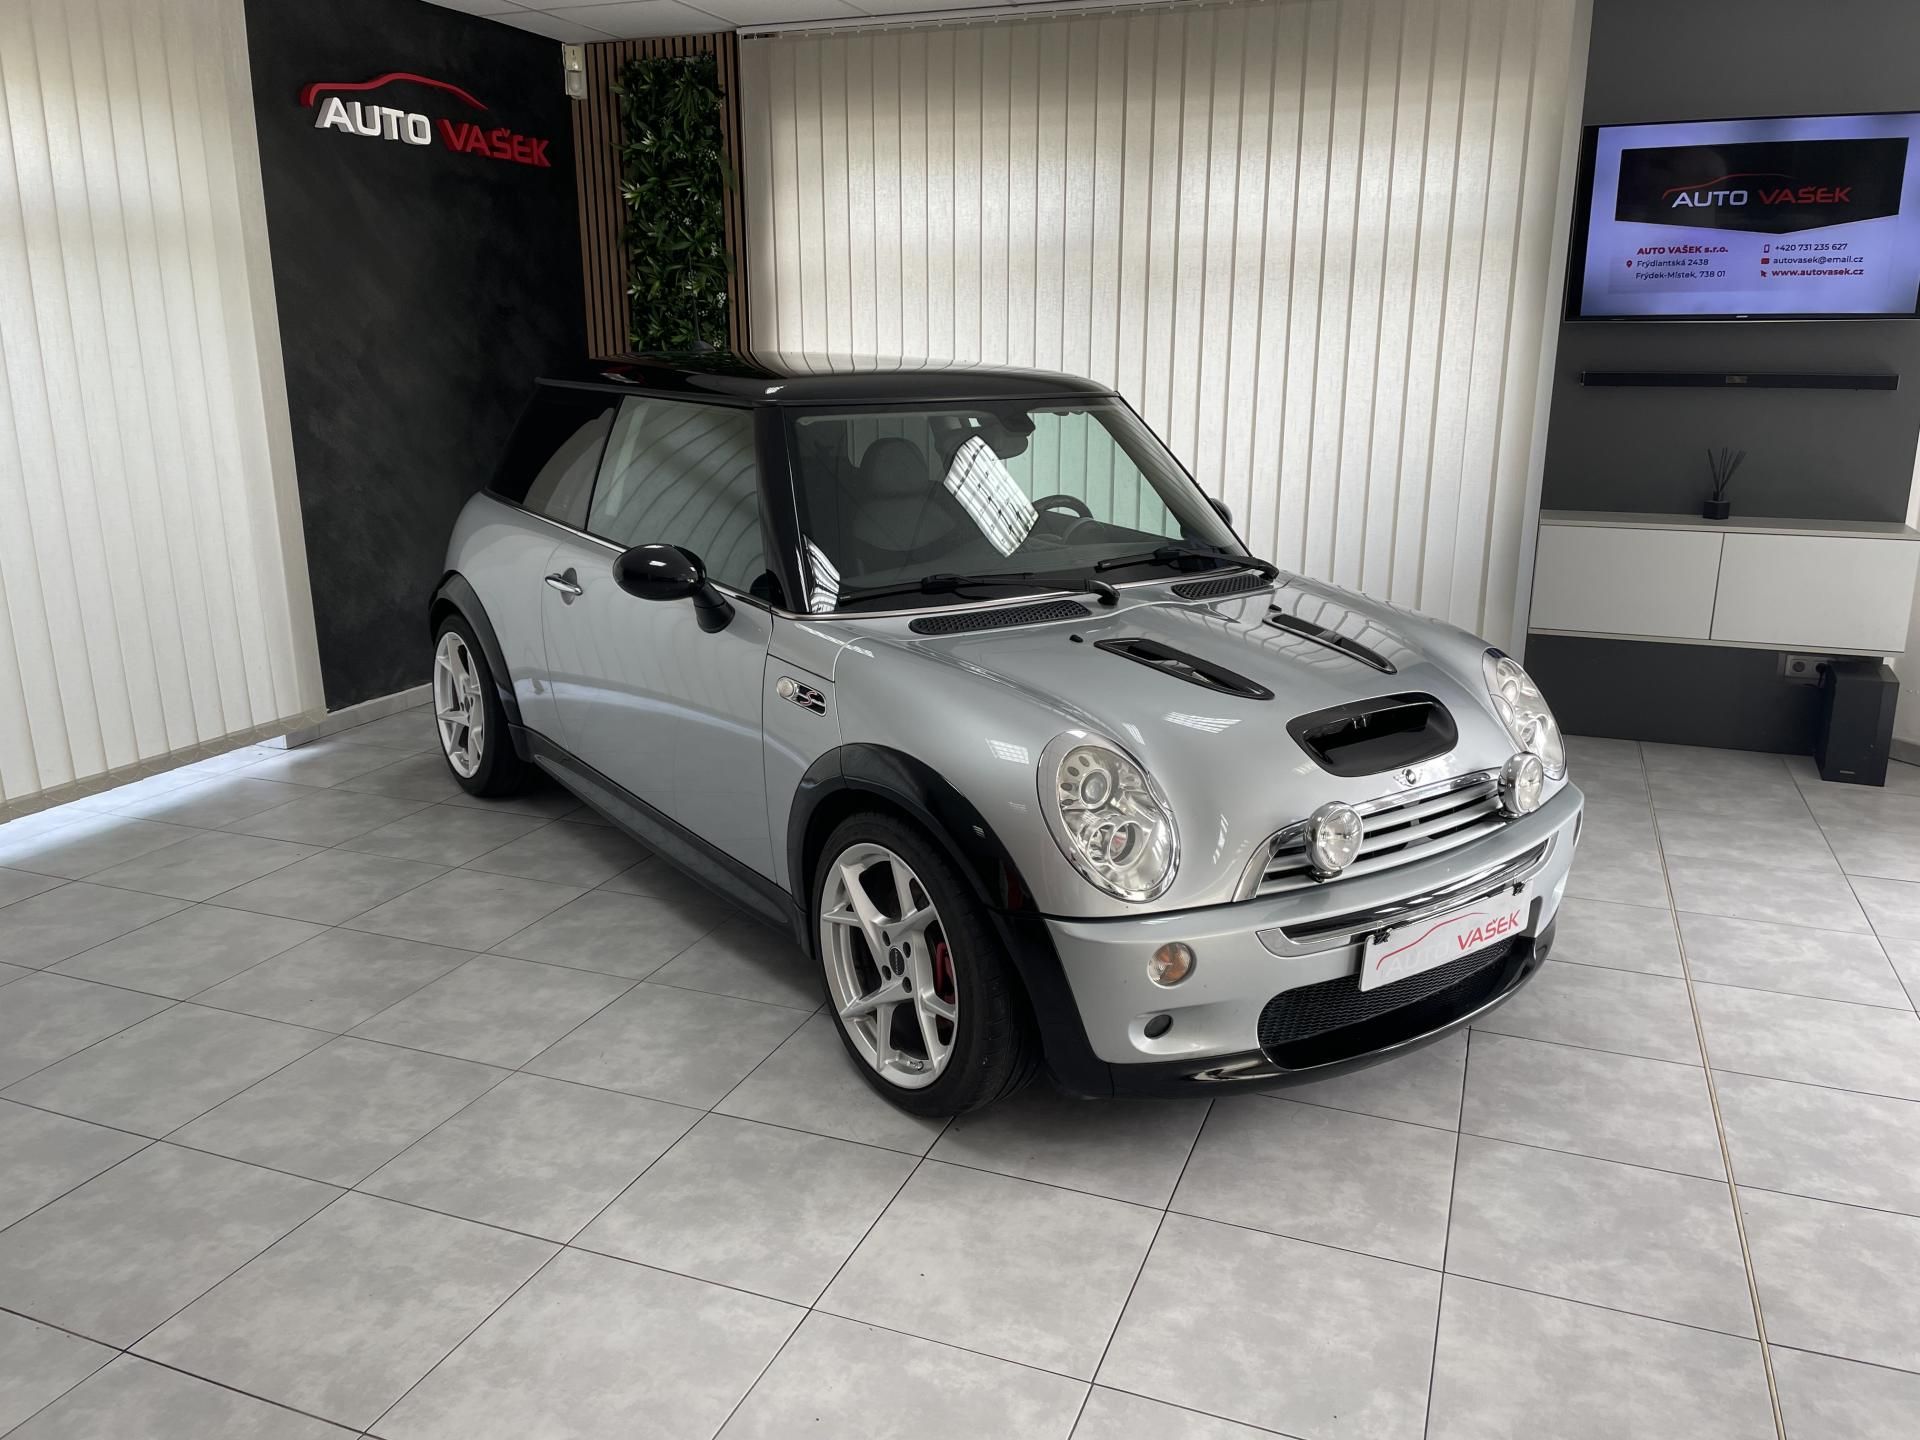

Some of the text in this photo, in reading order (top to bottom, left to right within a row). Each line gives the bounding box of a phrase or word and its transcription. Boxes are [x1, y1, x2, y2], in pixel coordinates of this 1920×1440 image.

[315, 96, 551, 167] AUTO VAŠEK
[1672, 186, 1852, 208] AUTO VAŠEK
[1637, 247, 1666, 255] AUTO
[1668, 244, 1702, 254] VAŠEK
[1775, 244, 1797, 252] +420
[1798, 243, 1812, 251] 731
[1814, 243, 1830, 251] 235
[1687, 258, 1709, 266] 2438
[1773, 256, 1864, 265] autovasek@email.cz
[1699, 270, 1715, 278] 738
[1772, 268, 1864, 277] www.autovasek.cz
[1457, 909, 1521, 951] VAŠEK
